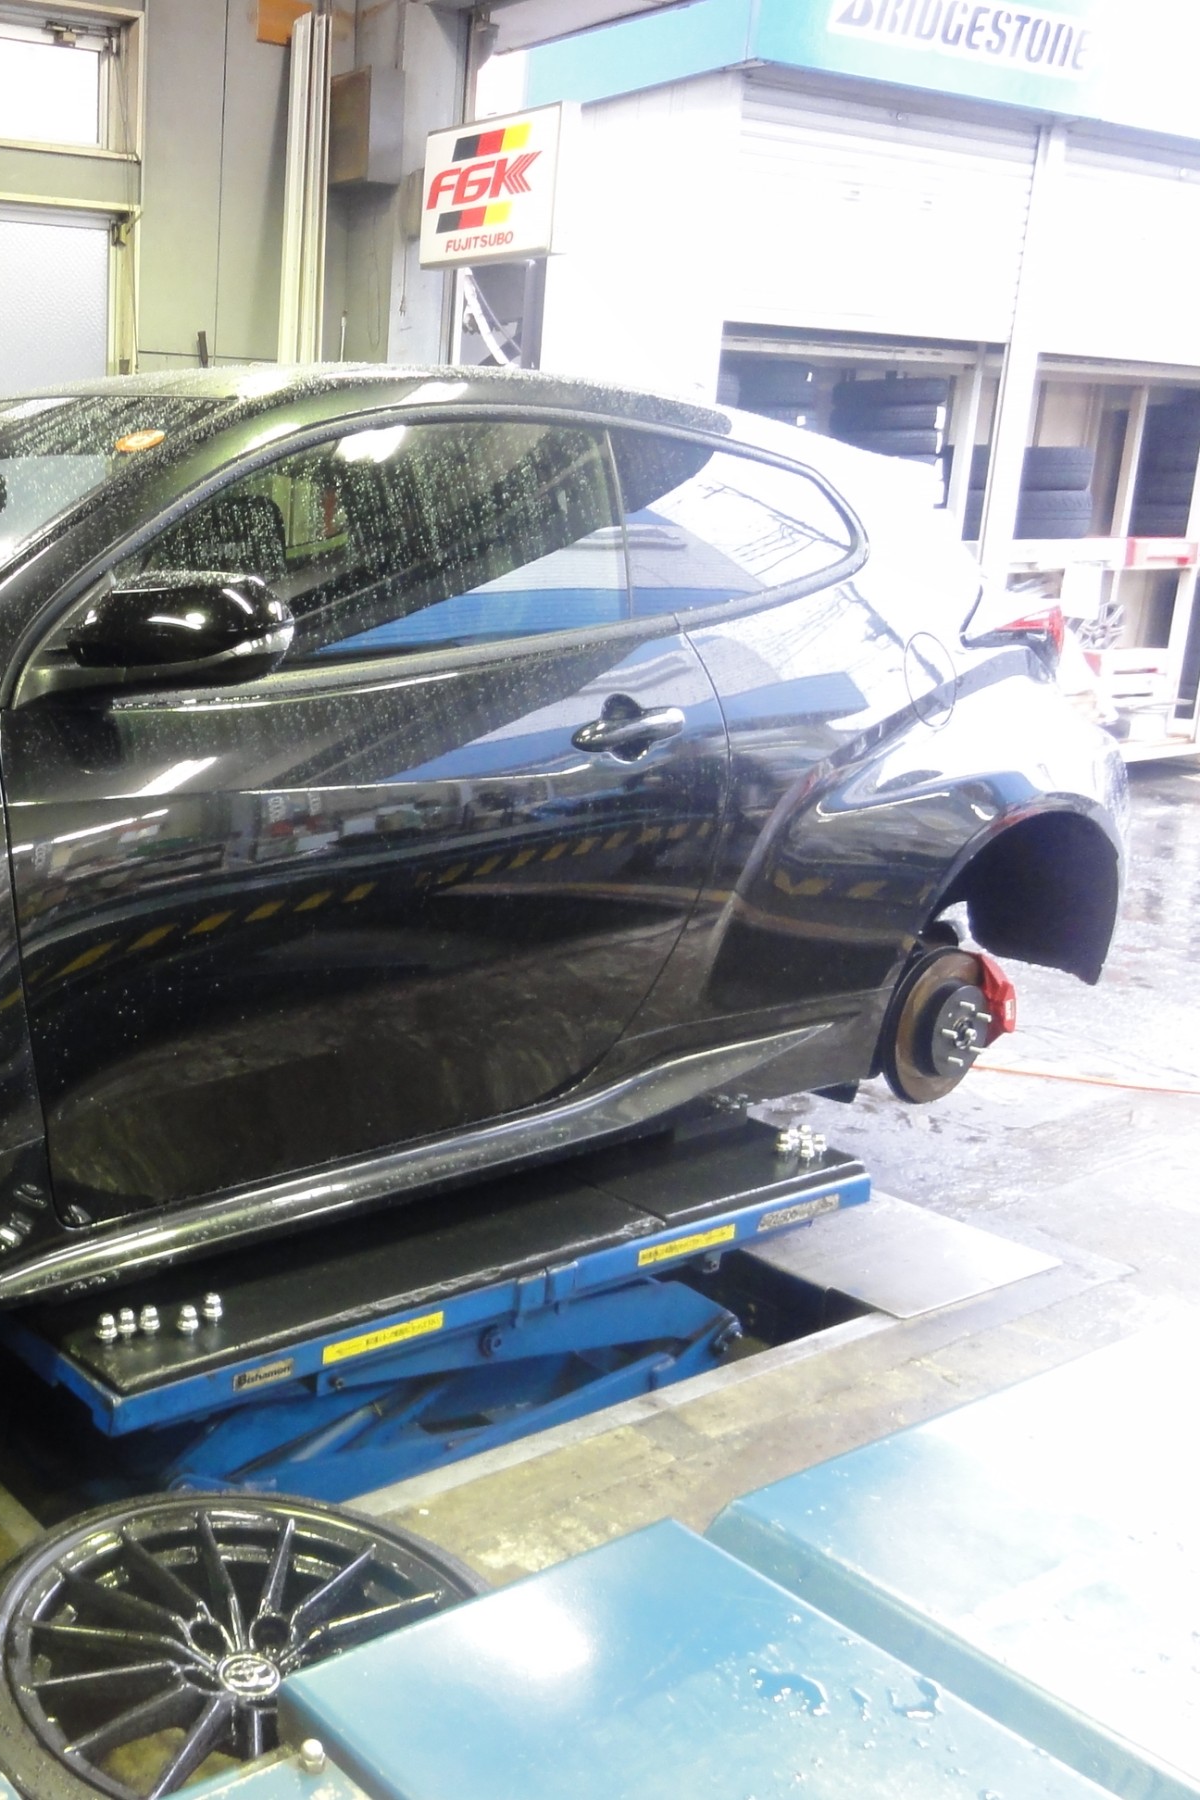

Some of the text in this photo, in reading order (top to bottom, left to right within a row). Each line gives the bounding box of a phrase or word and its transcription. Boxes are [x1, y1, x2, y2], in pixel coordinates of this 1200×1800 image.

[835, 0, 1092, 70] BRIDGESTONE
[425, 150, 543, 210] FGK
[445, 231, 514, 253] FUJITSUBO
